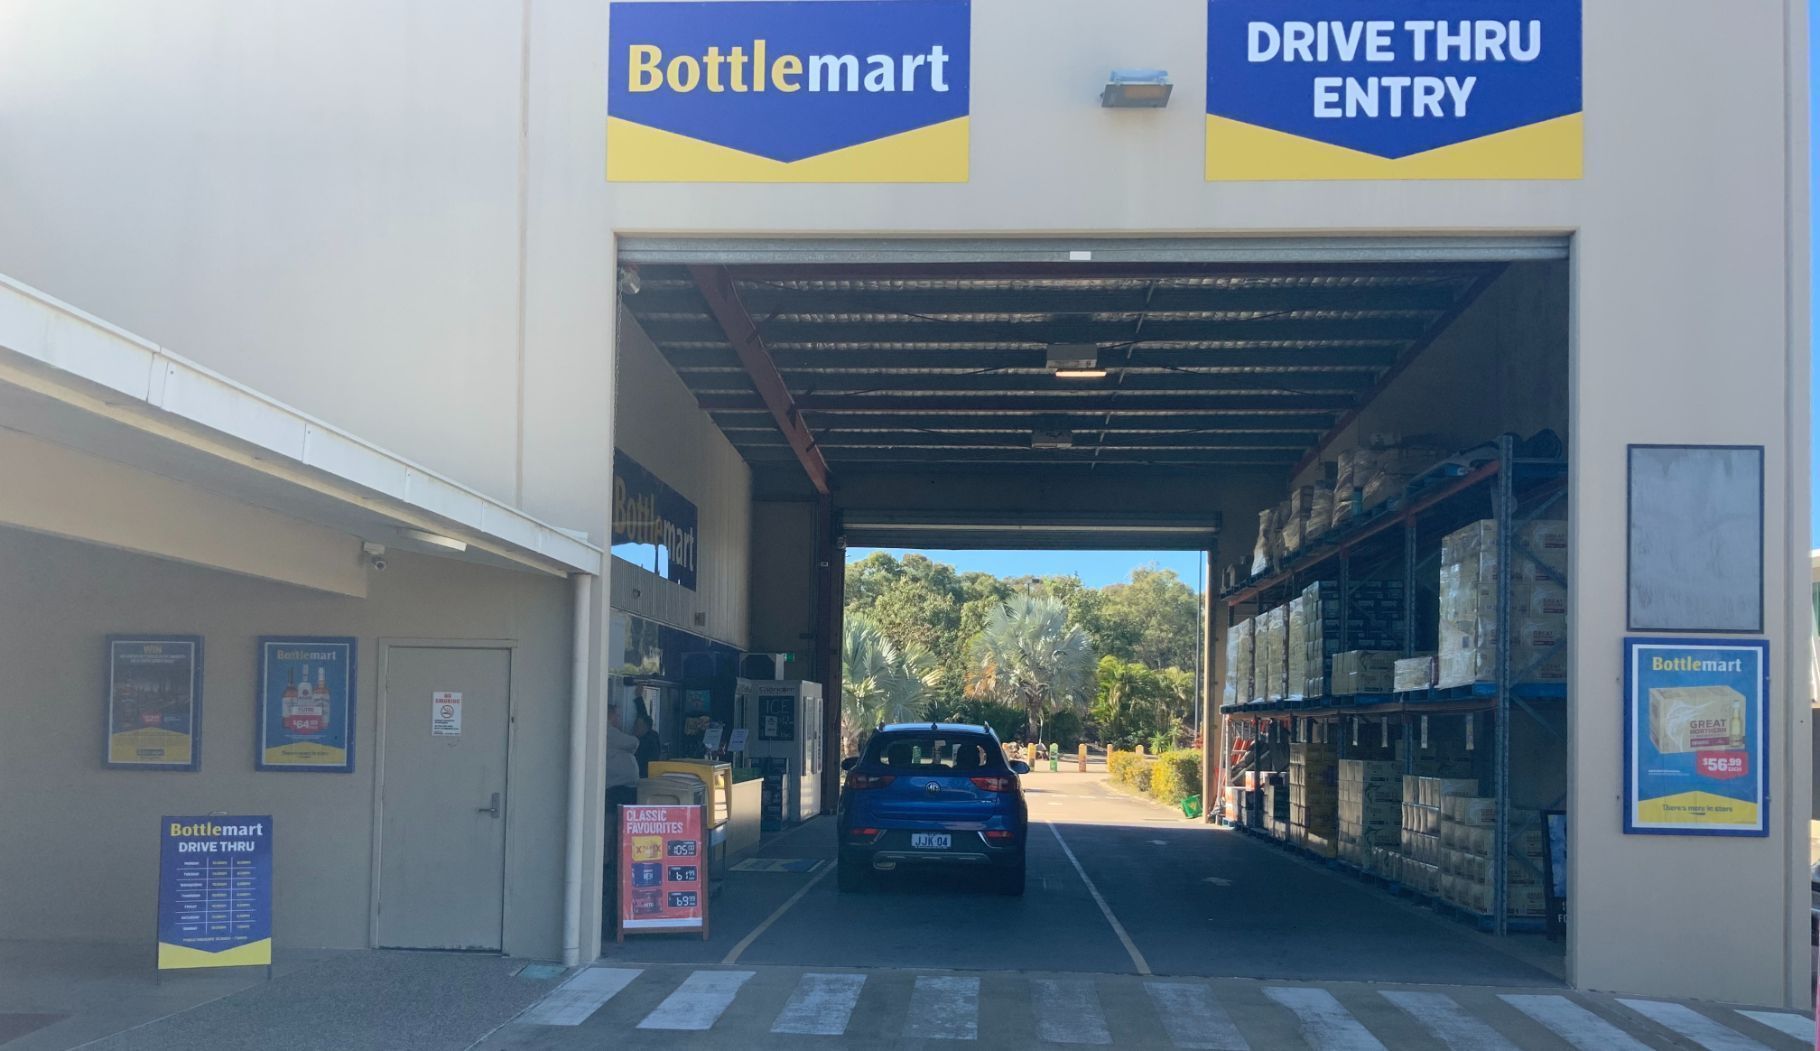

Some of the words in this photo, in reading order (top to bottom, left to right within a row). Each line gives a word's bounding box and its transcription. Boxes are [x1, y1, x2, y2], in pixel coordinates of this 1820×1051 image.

[1248, 21, 1395, 62] DRIVE
[1404, 20, 1541, 61] THRU
[628, 40, 949, 93] Bottlemart
[1313, 76, 1477, 118] ENTRY
[613, 474, 694, 572] Bottlemart
[276, 648, 337, 661] Bottlemart
[1652, 656, 1742, 672] Bottlemart
[1690, 719, 1727, 729] GREAT
[626, 809, 667, 822] CLASSIC
[170, 822, 263, 837] Bottlemart
[626, 821, 683, 834] FAVOURITES
[178, 841, 218, 853] DRIVE
[219, 840, 255, 852] THRU
